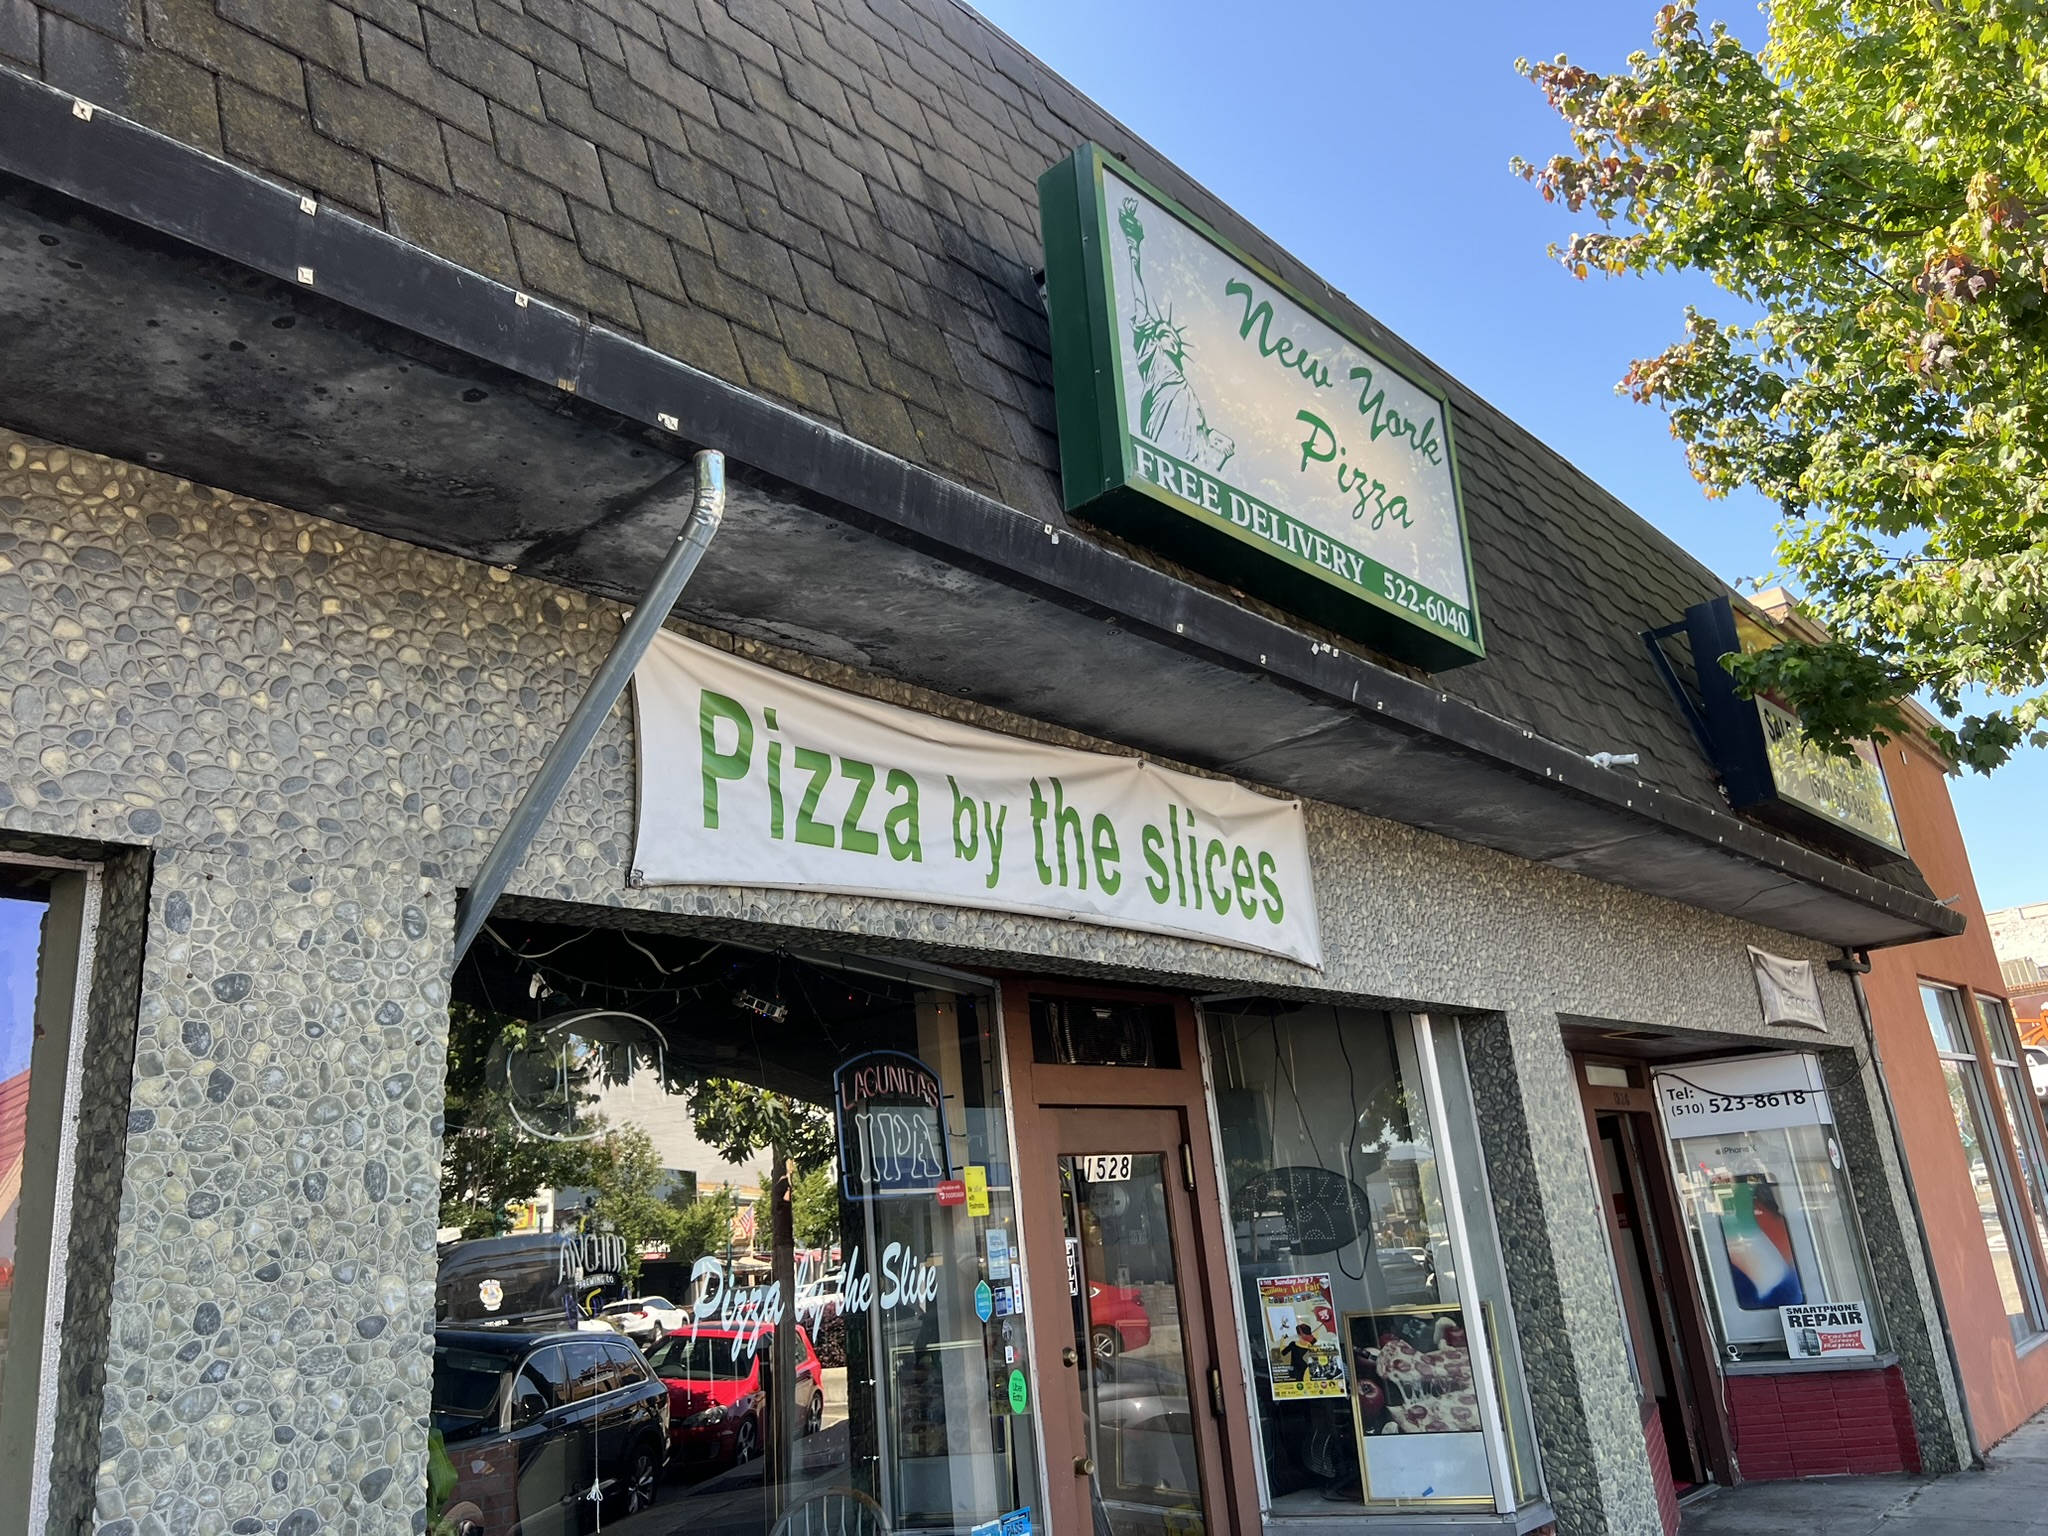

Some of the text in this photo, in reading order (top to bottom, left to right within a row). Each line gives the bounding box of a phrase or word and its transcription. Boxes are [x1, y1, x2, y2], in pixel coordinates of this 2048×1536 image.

[1225, 277, 1443, 466] New York
[1295, 408, 1414, 531] Pizza
[1133, 443, 1470, 638] FREE DELIVERY 522-6040
[699, 688, 1285, 925] Pizza by the slices
[1666, 1086, 1694, 1100] Tel:
[1671, 1089, 1806, 1117] (510) 523-8618
[854, 1113, 942, 1183] IPA
[1086, 1156, 1130, 1181] 1528
[1290, 1173, 1364, 1215] PIZZA
[1065, 1242, 1077, 1294] PULL
[1275, 1278, 1296, 1286] Sunday
[1305, 1281, 1321, 1292] Fair
[690, 1255, 786, 1362] Pizza
[835, 1245, 874, 1314] the
[880, 1241, 939, 1311] Slice
[1786, 1303, 1859, 1315] SMARTPHONE
[1787, 1311, 1863, 1329] REPAIR
[1821, 1332, 1859, 1340] Cracked
[1823, 1342, 1861, 1350] Repair
[1006, 1521, 1023, 1536] PASS
